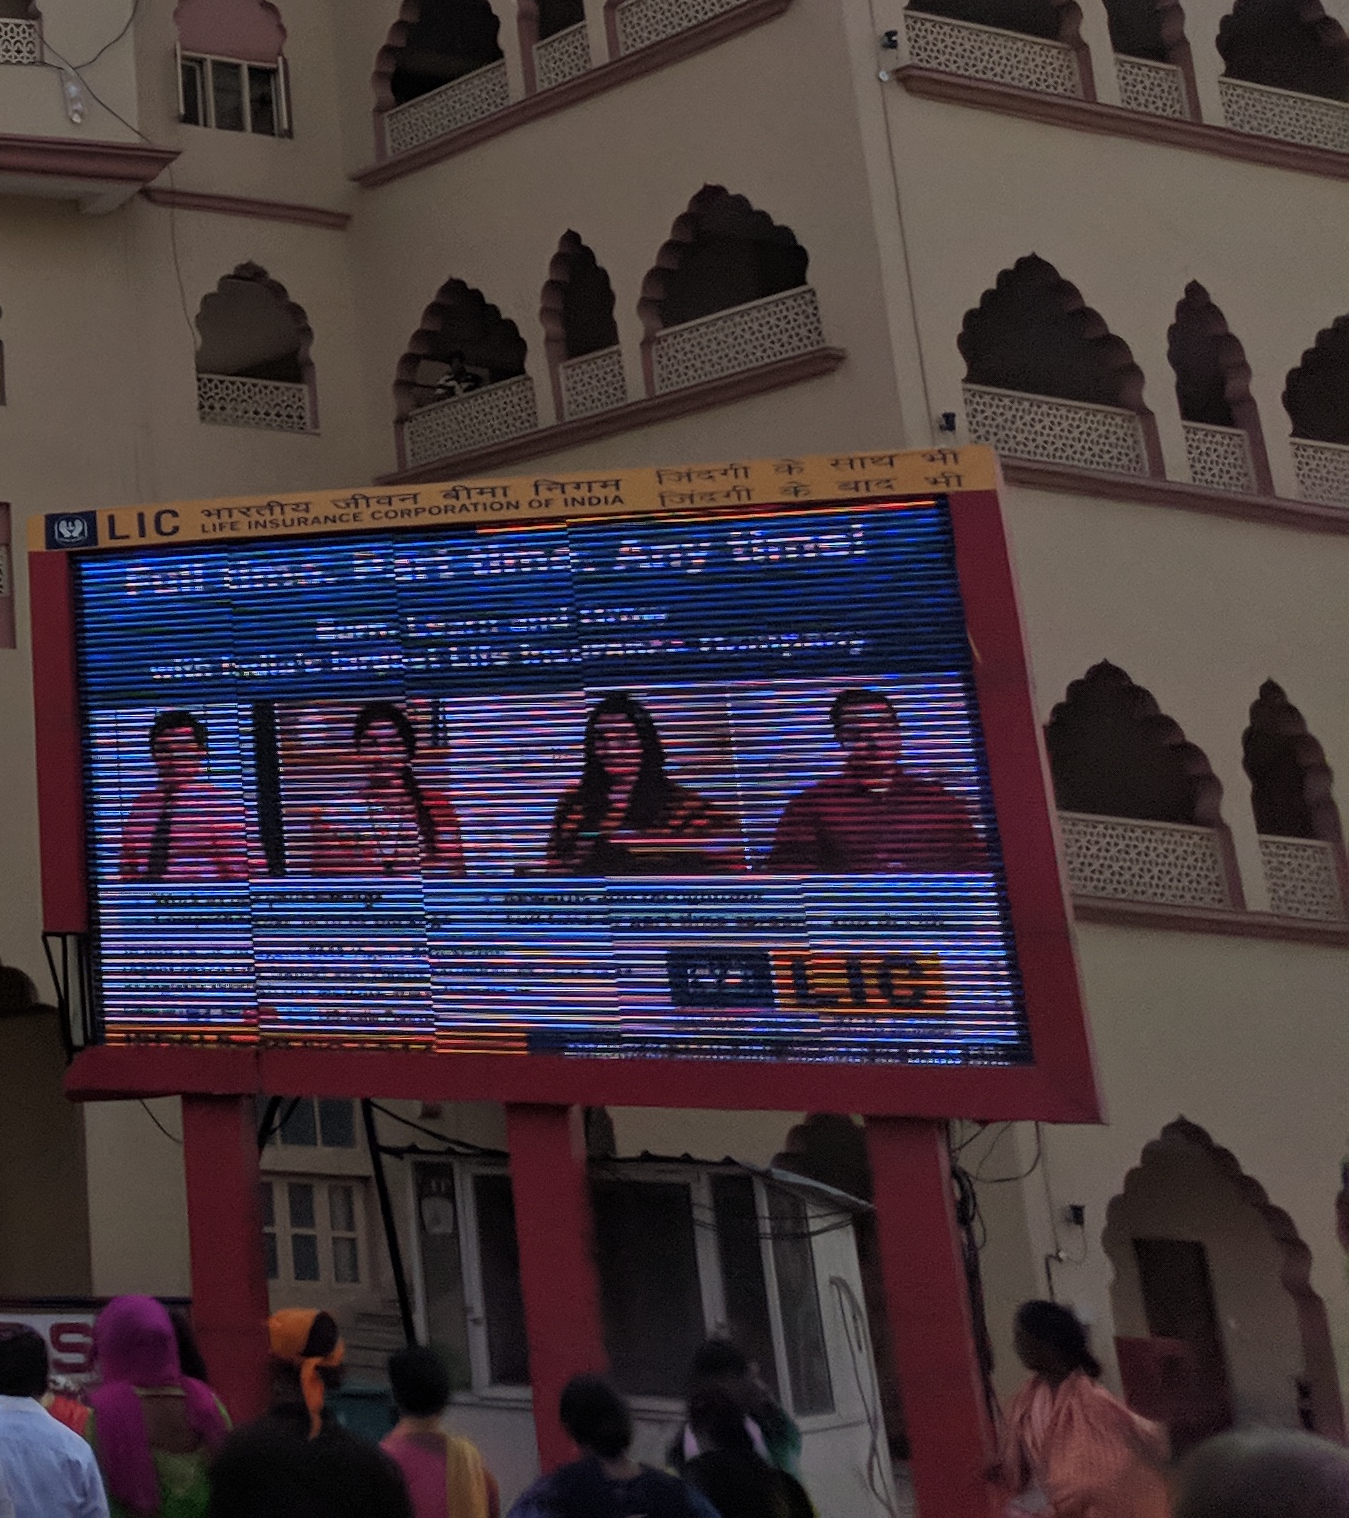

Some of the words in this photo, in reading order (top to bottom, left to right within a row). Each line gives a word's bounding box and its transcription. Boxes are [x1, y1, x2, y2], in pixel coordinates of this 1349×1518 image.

[656, 463, 751, 484] जिंदगी
[773, 458, 804, 476] के
[830, 453, 897, 470] साथ
[922, 449, 961, 466] भी
[779, 481, 812, 498] के
[837, 478, 898, 494] बाद
[924, 471, 964, 488] भी
[201, 500, 312, 520] भारतीय
[330, 493, 422, 511] जीवन
[441, 484, 510, 501] बीमा
[533, 478, 622, 496] निगम
[201, 520, 244, 534] LIFE
[247, 511, 363, 531] INSURANCE
[370, 498, 521, 520] CORPORATION
[527, 497, 553, 510] OF
[563, 494, 625, 508] INDIA
[107, 508, 181, 540] LIC
[790, 953, 928, 1007] LIC
